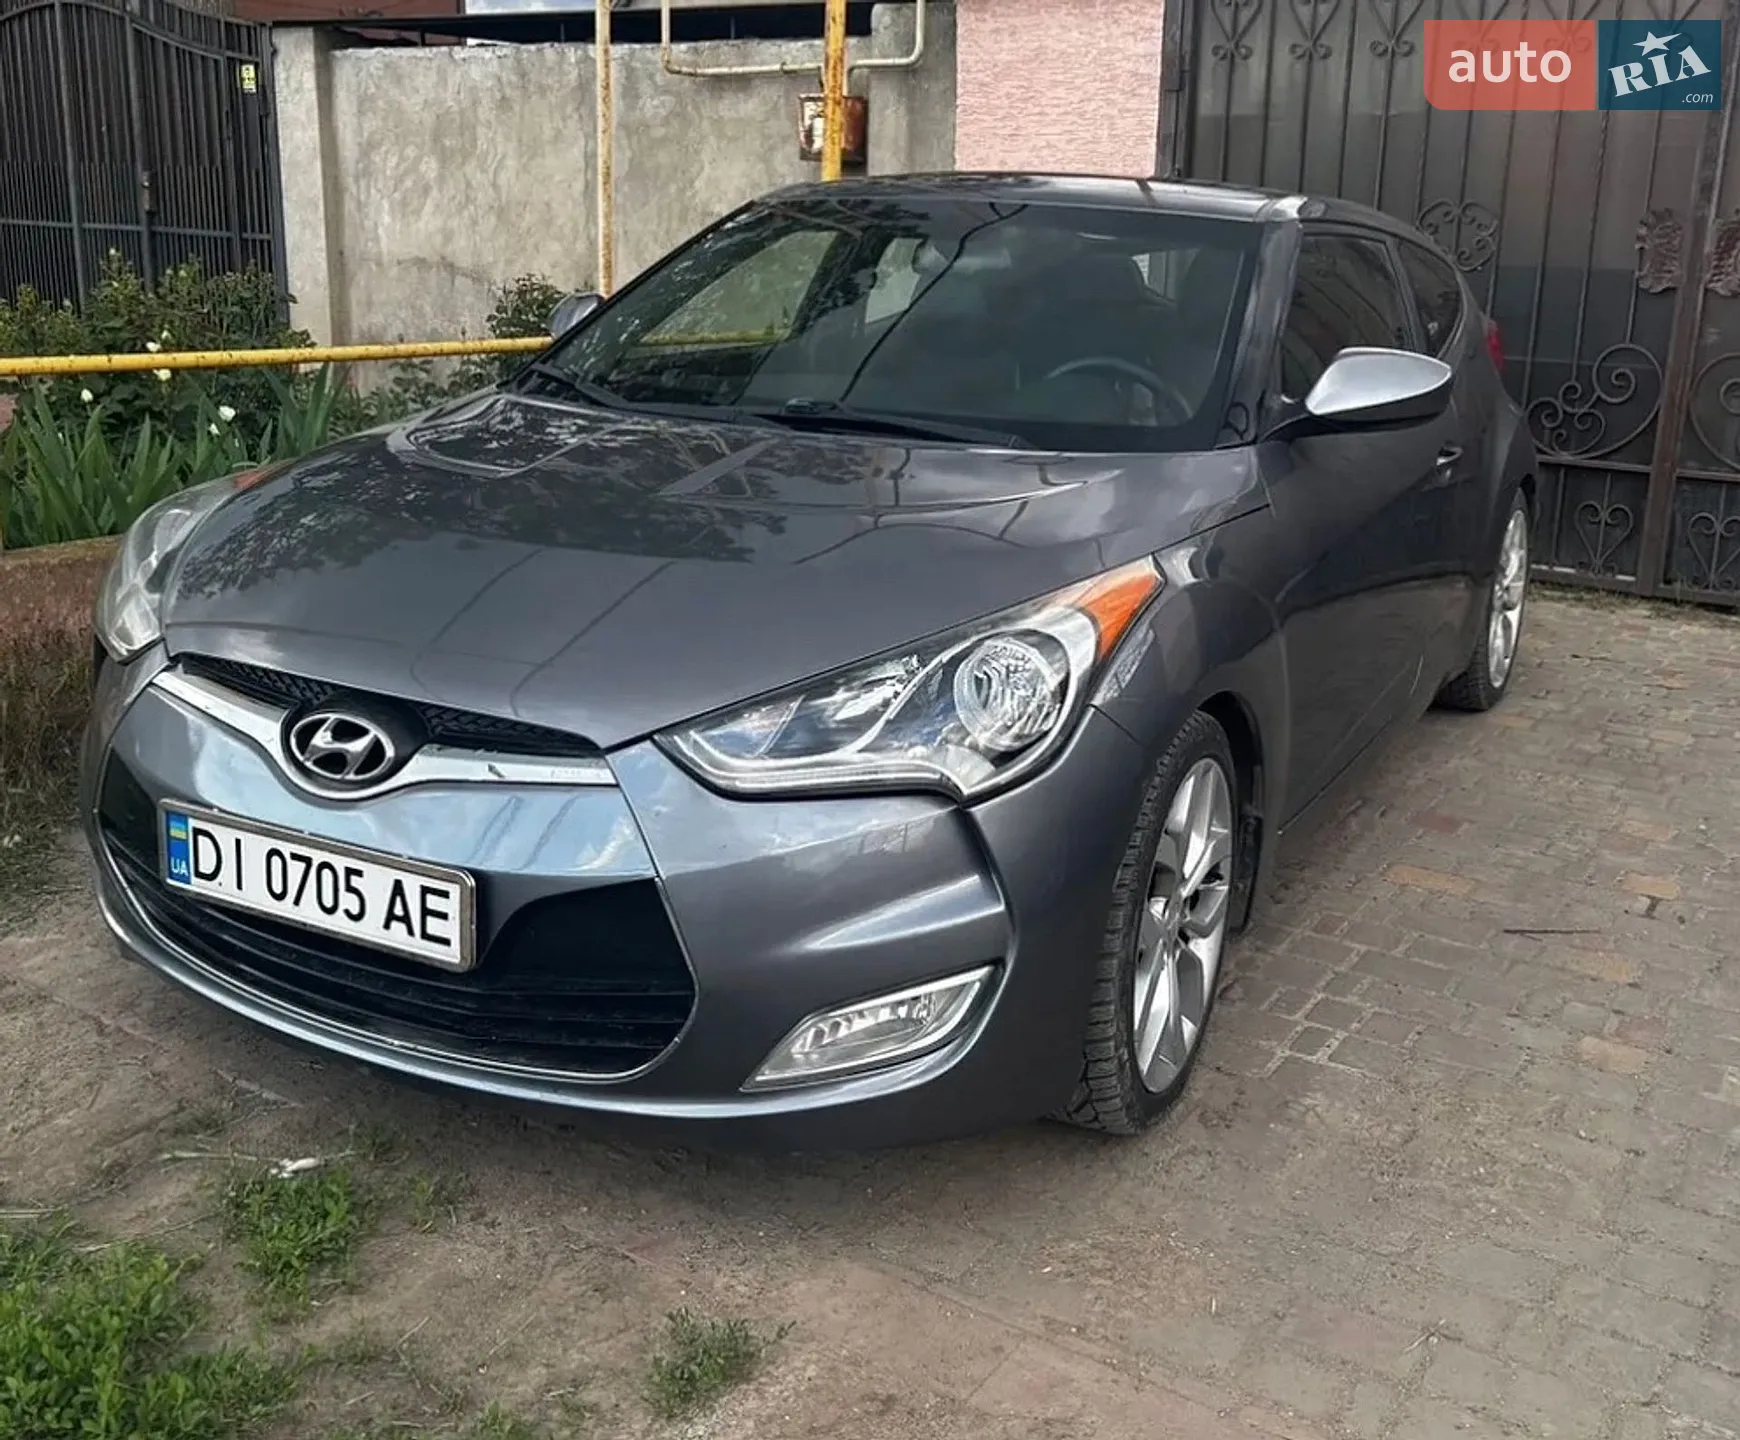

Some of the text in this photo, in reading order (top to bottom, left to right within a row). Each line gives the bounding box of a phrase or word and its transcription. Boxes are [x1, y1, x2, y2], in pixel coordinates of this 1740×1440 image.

[170, 858, 189, 876] UA
[192, 827, 452, 947] DI 0705 AE
